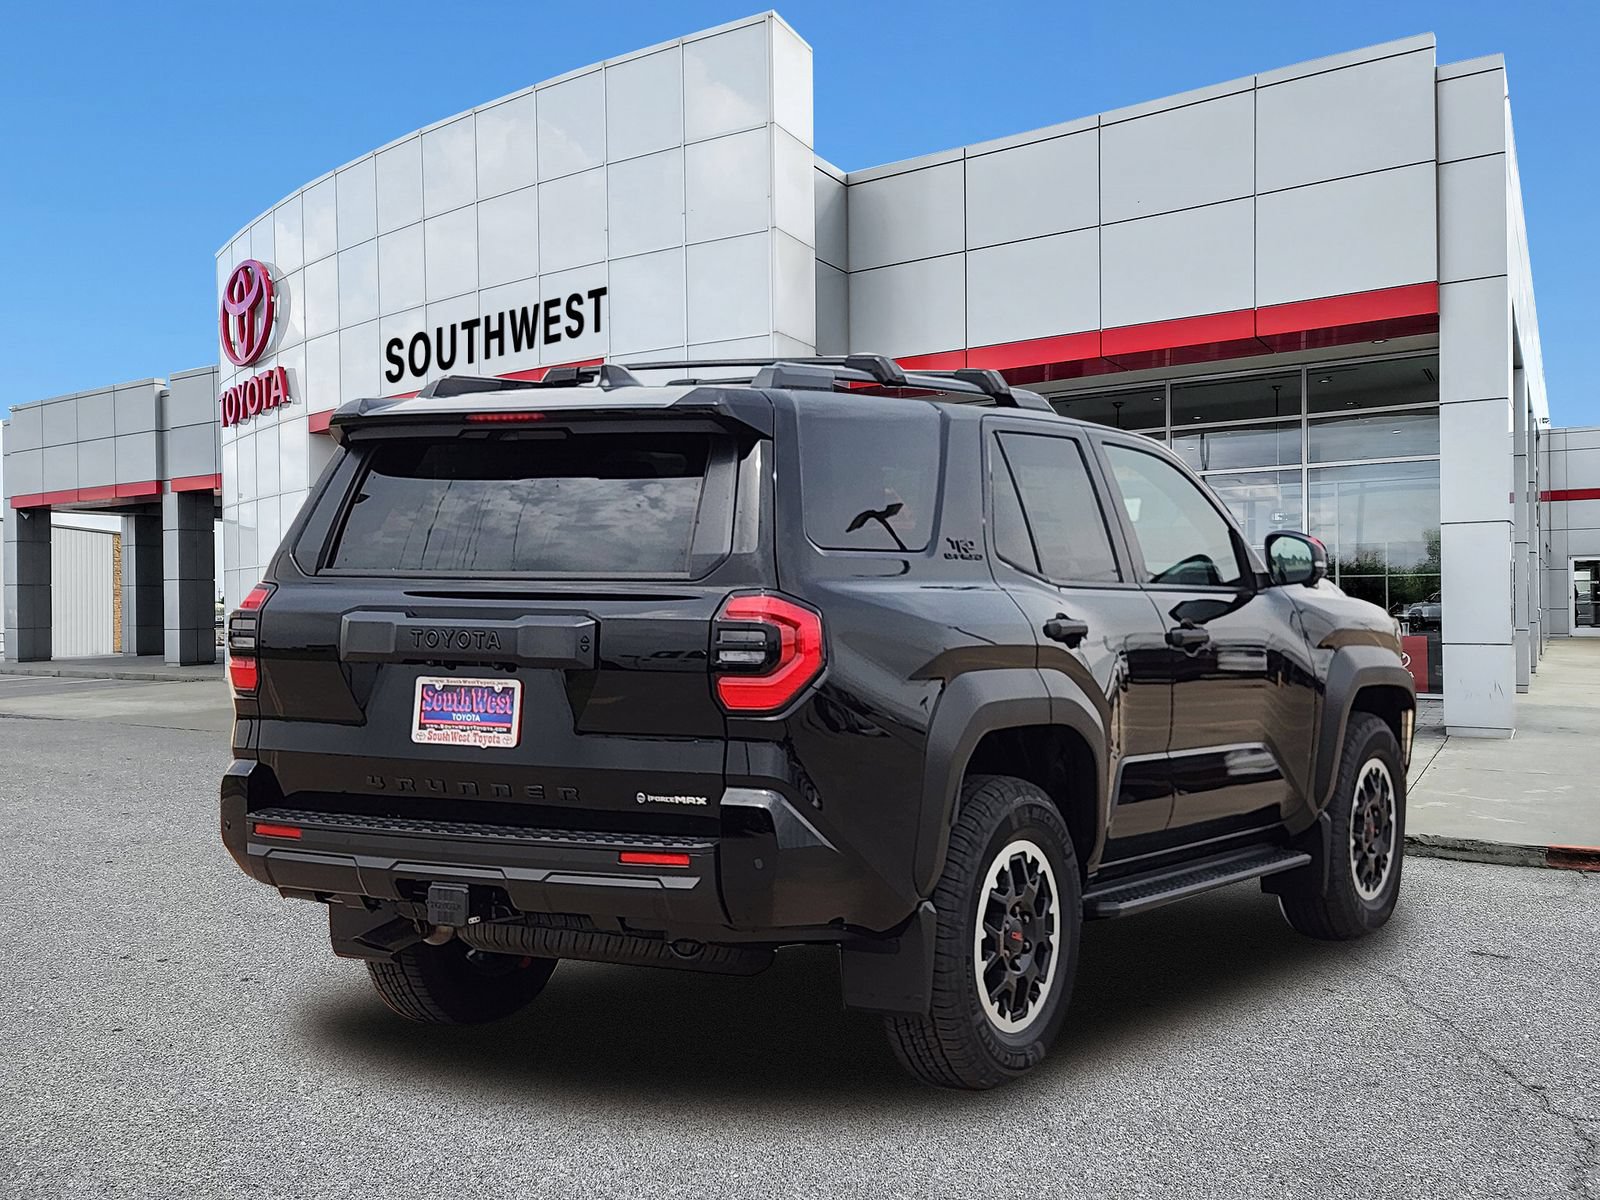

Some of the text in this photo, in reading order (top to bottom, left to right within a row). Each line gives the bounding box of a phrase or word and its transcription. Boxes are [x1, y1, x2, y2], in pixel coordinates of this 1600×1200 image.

[385, 286, 608, 384] SOUTHWEST
[219, 366, 288, 429] TOYOTA
[410, 628, 502, 651] TOYOTA
[452, 713, 481, 722] TOYOTA
[473, 732, 501, 746] Toyota
[365, 775, 581, 802] 4RUNNER
